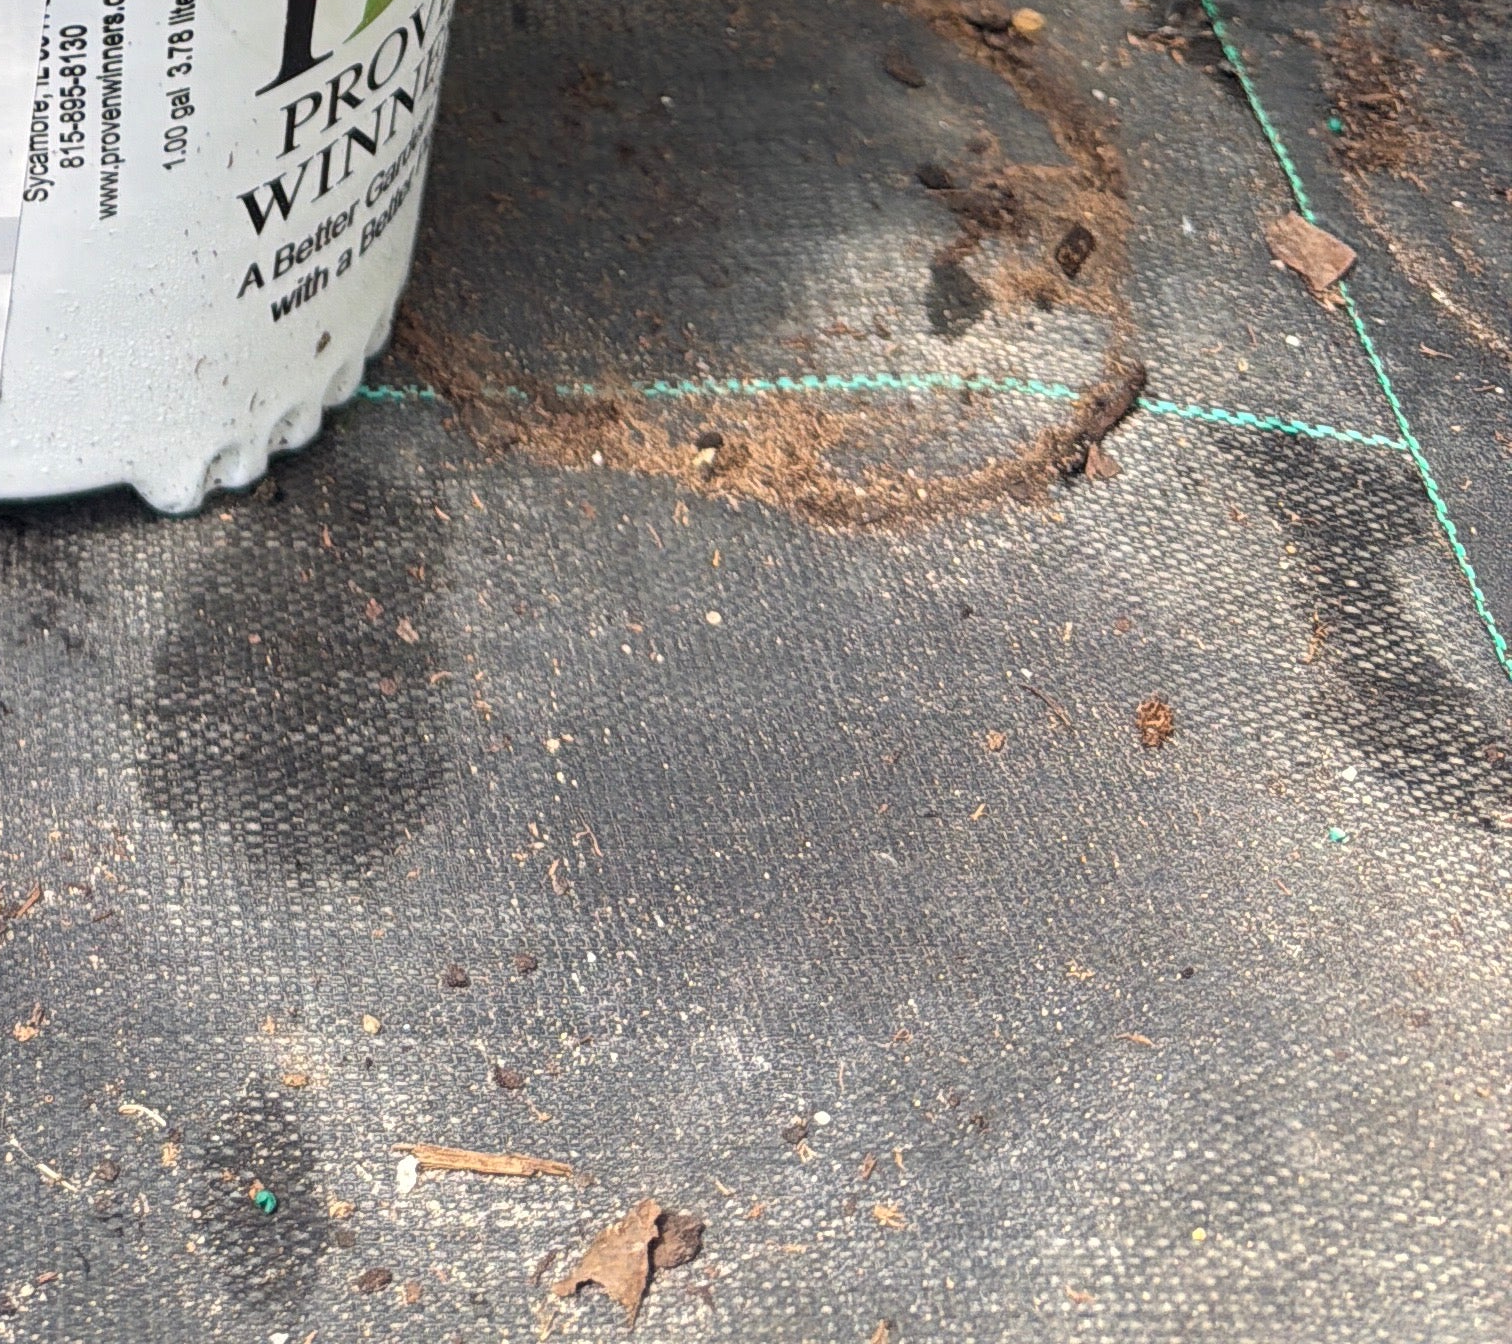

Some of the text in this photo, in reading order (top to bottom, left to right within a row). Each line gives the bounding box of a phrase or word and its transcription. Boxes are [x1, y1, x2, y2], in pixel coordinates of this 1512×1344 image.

[166, 28, 194, 78] 3.78
[59, 24, 88, 169] 815-895-8130
[166, 87, 195, 120] gal
[23, 91, 55, 203] Sycamore,
[162, 124, 188, 171] 1.00
[237, 262, 266, 298] A
[272, 204, 357, 282] Better
[270, 271, 330, 323] with
[335, 247, 354, 275] a
